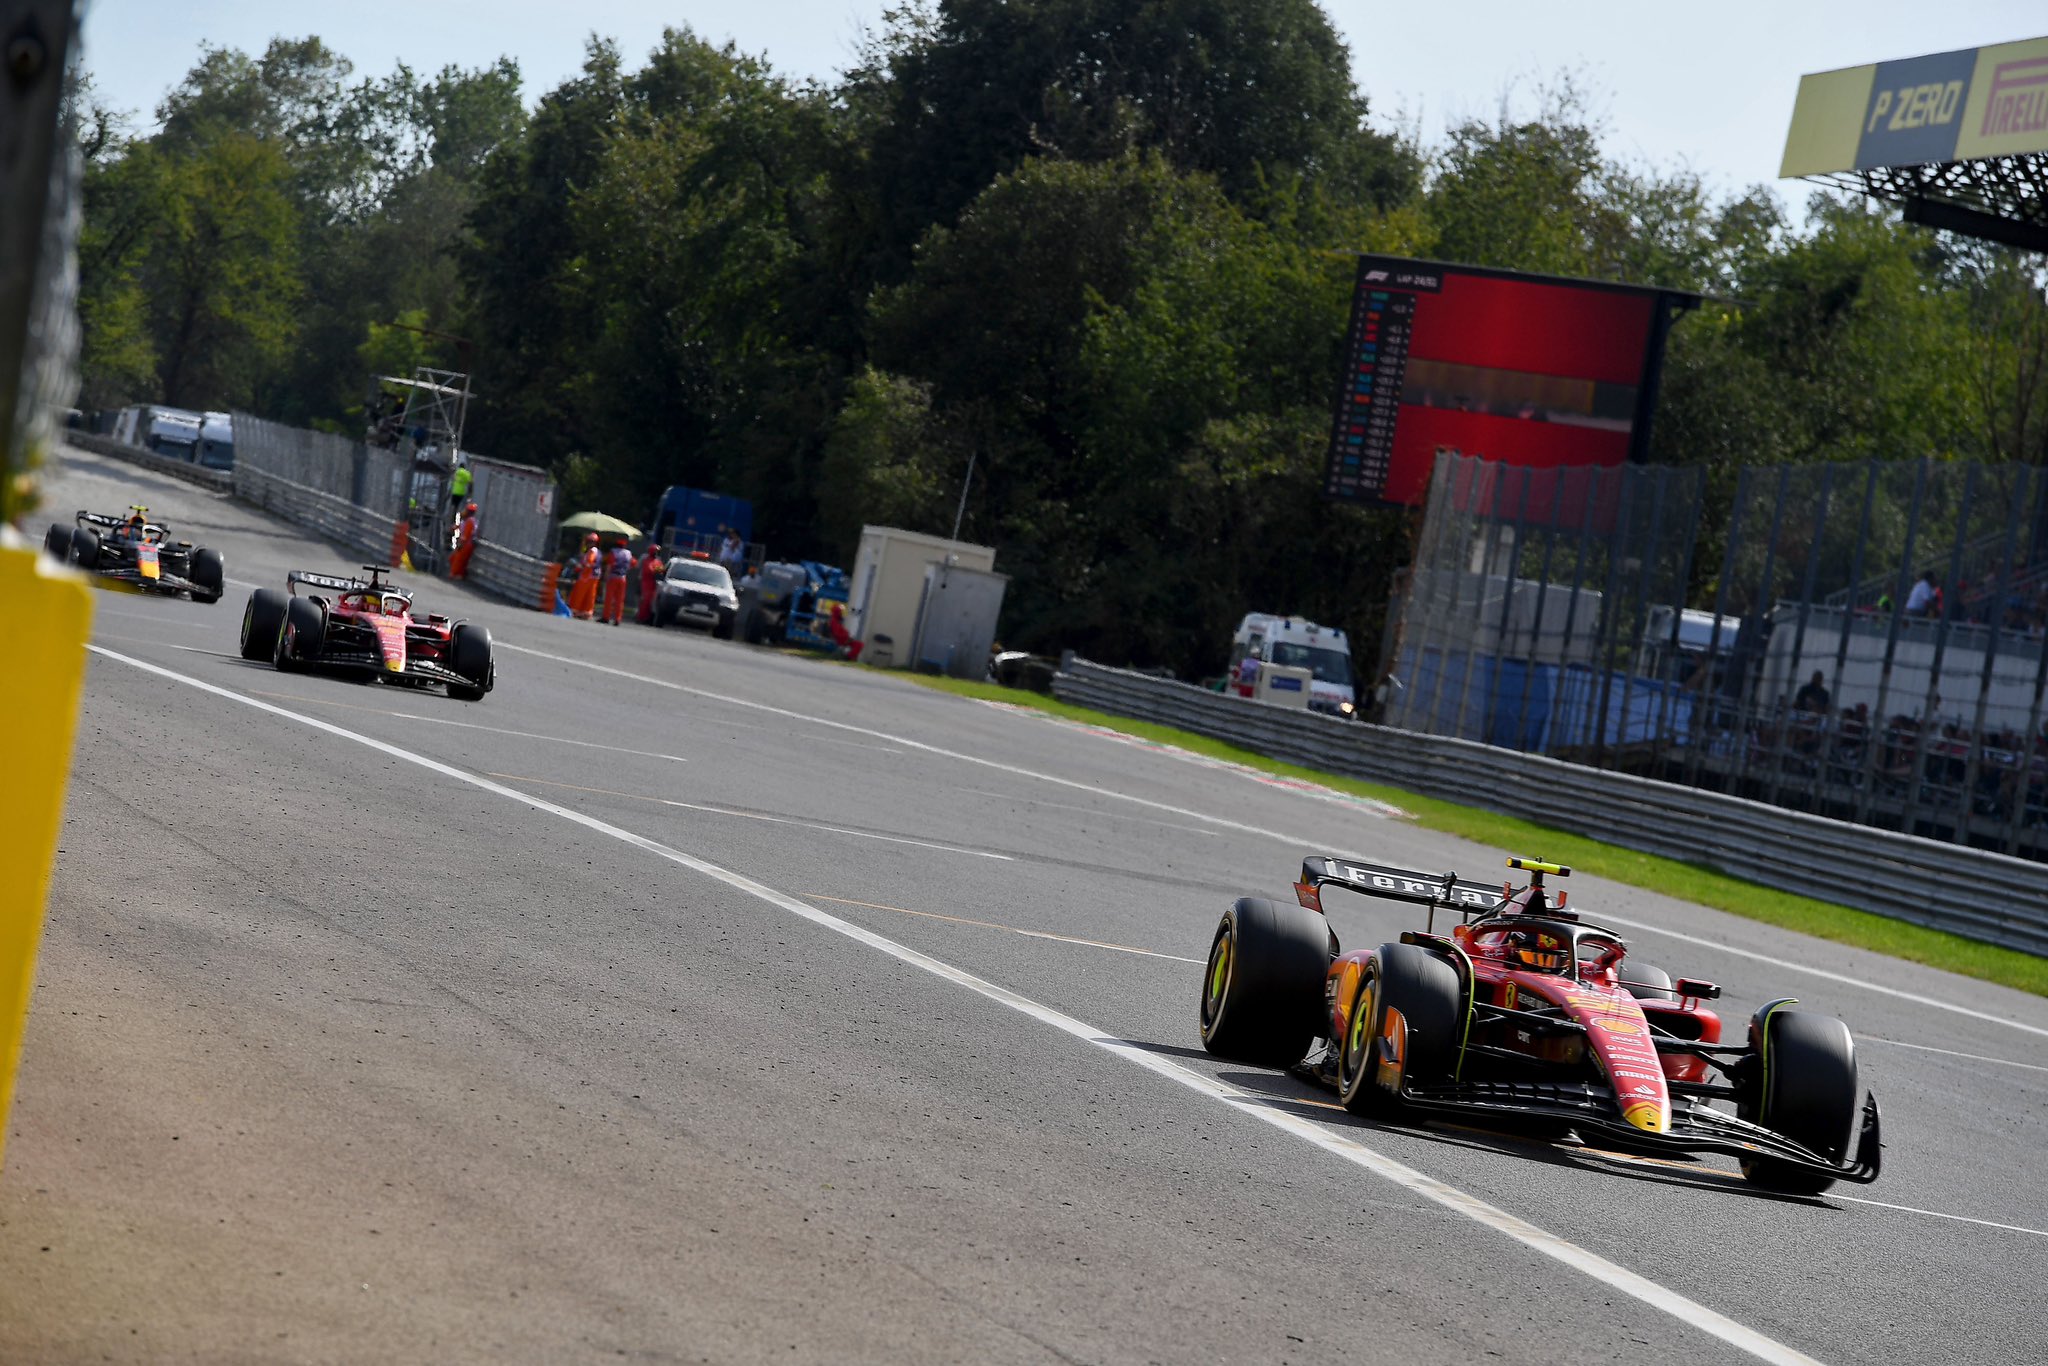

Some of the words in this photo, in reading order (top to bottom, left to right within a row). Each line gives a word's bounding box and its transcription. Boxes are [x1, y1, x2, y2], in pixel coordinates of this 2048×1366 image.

[1867, 90, 1893, 133] P
[1888, 79, 1964, 131] ZERO
[1344, 865, 1553, 911] Ferra
[1619, 1092, 1664, 1103] Santand
